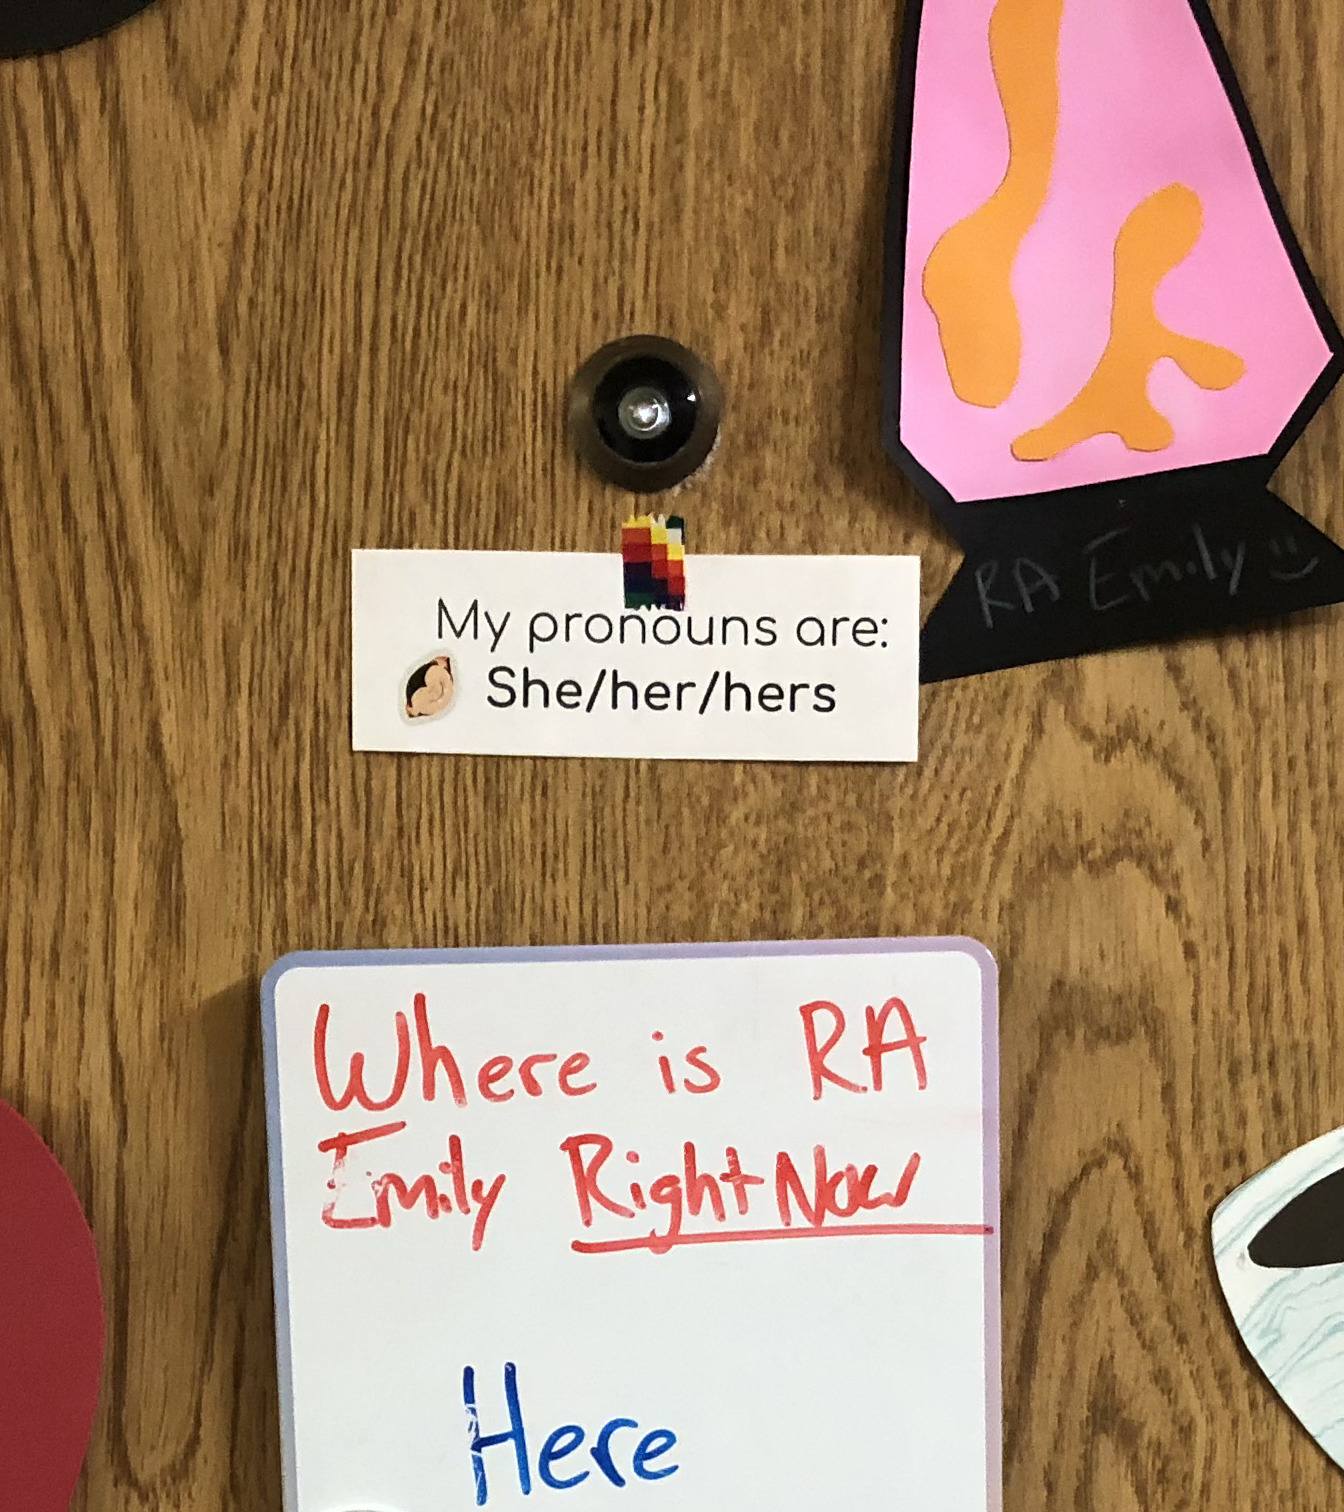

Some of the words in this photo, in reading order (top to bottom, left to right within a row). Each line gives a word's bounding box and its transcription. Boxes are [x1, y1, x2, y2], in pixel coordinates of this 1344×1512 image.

[436, 597, 510, 652] My
[528, 611, 778, 654] pronouns
[796, 614, 889, 648] are:
[975, 559, 1060, 629] RA
[1083, 523, 1247, 611] Emily
[486, 666, 837, 715] She/her/hers
[313, 993, 598, 1112] Where
[652, 1031, 721, 1094] is
[799, 997, 928, 1100] RA
[318, 1121, 506, 1250] Emily
[463, 1362, 680, 1506] Here
